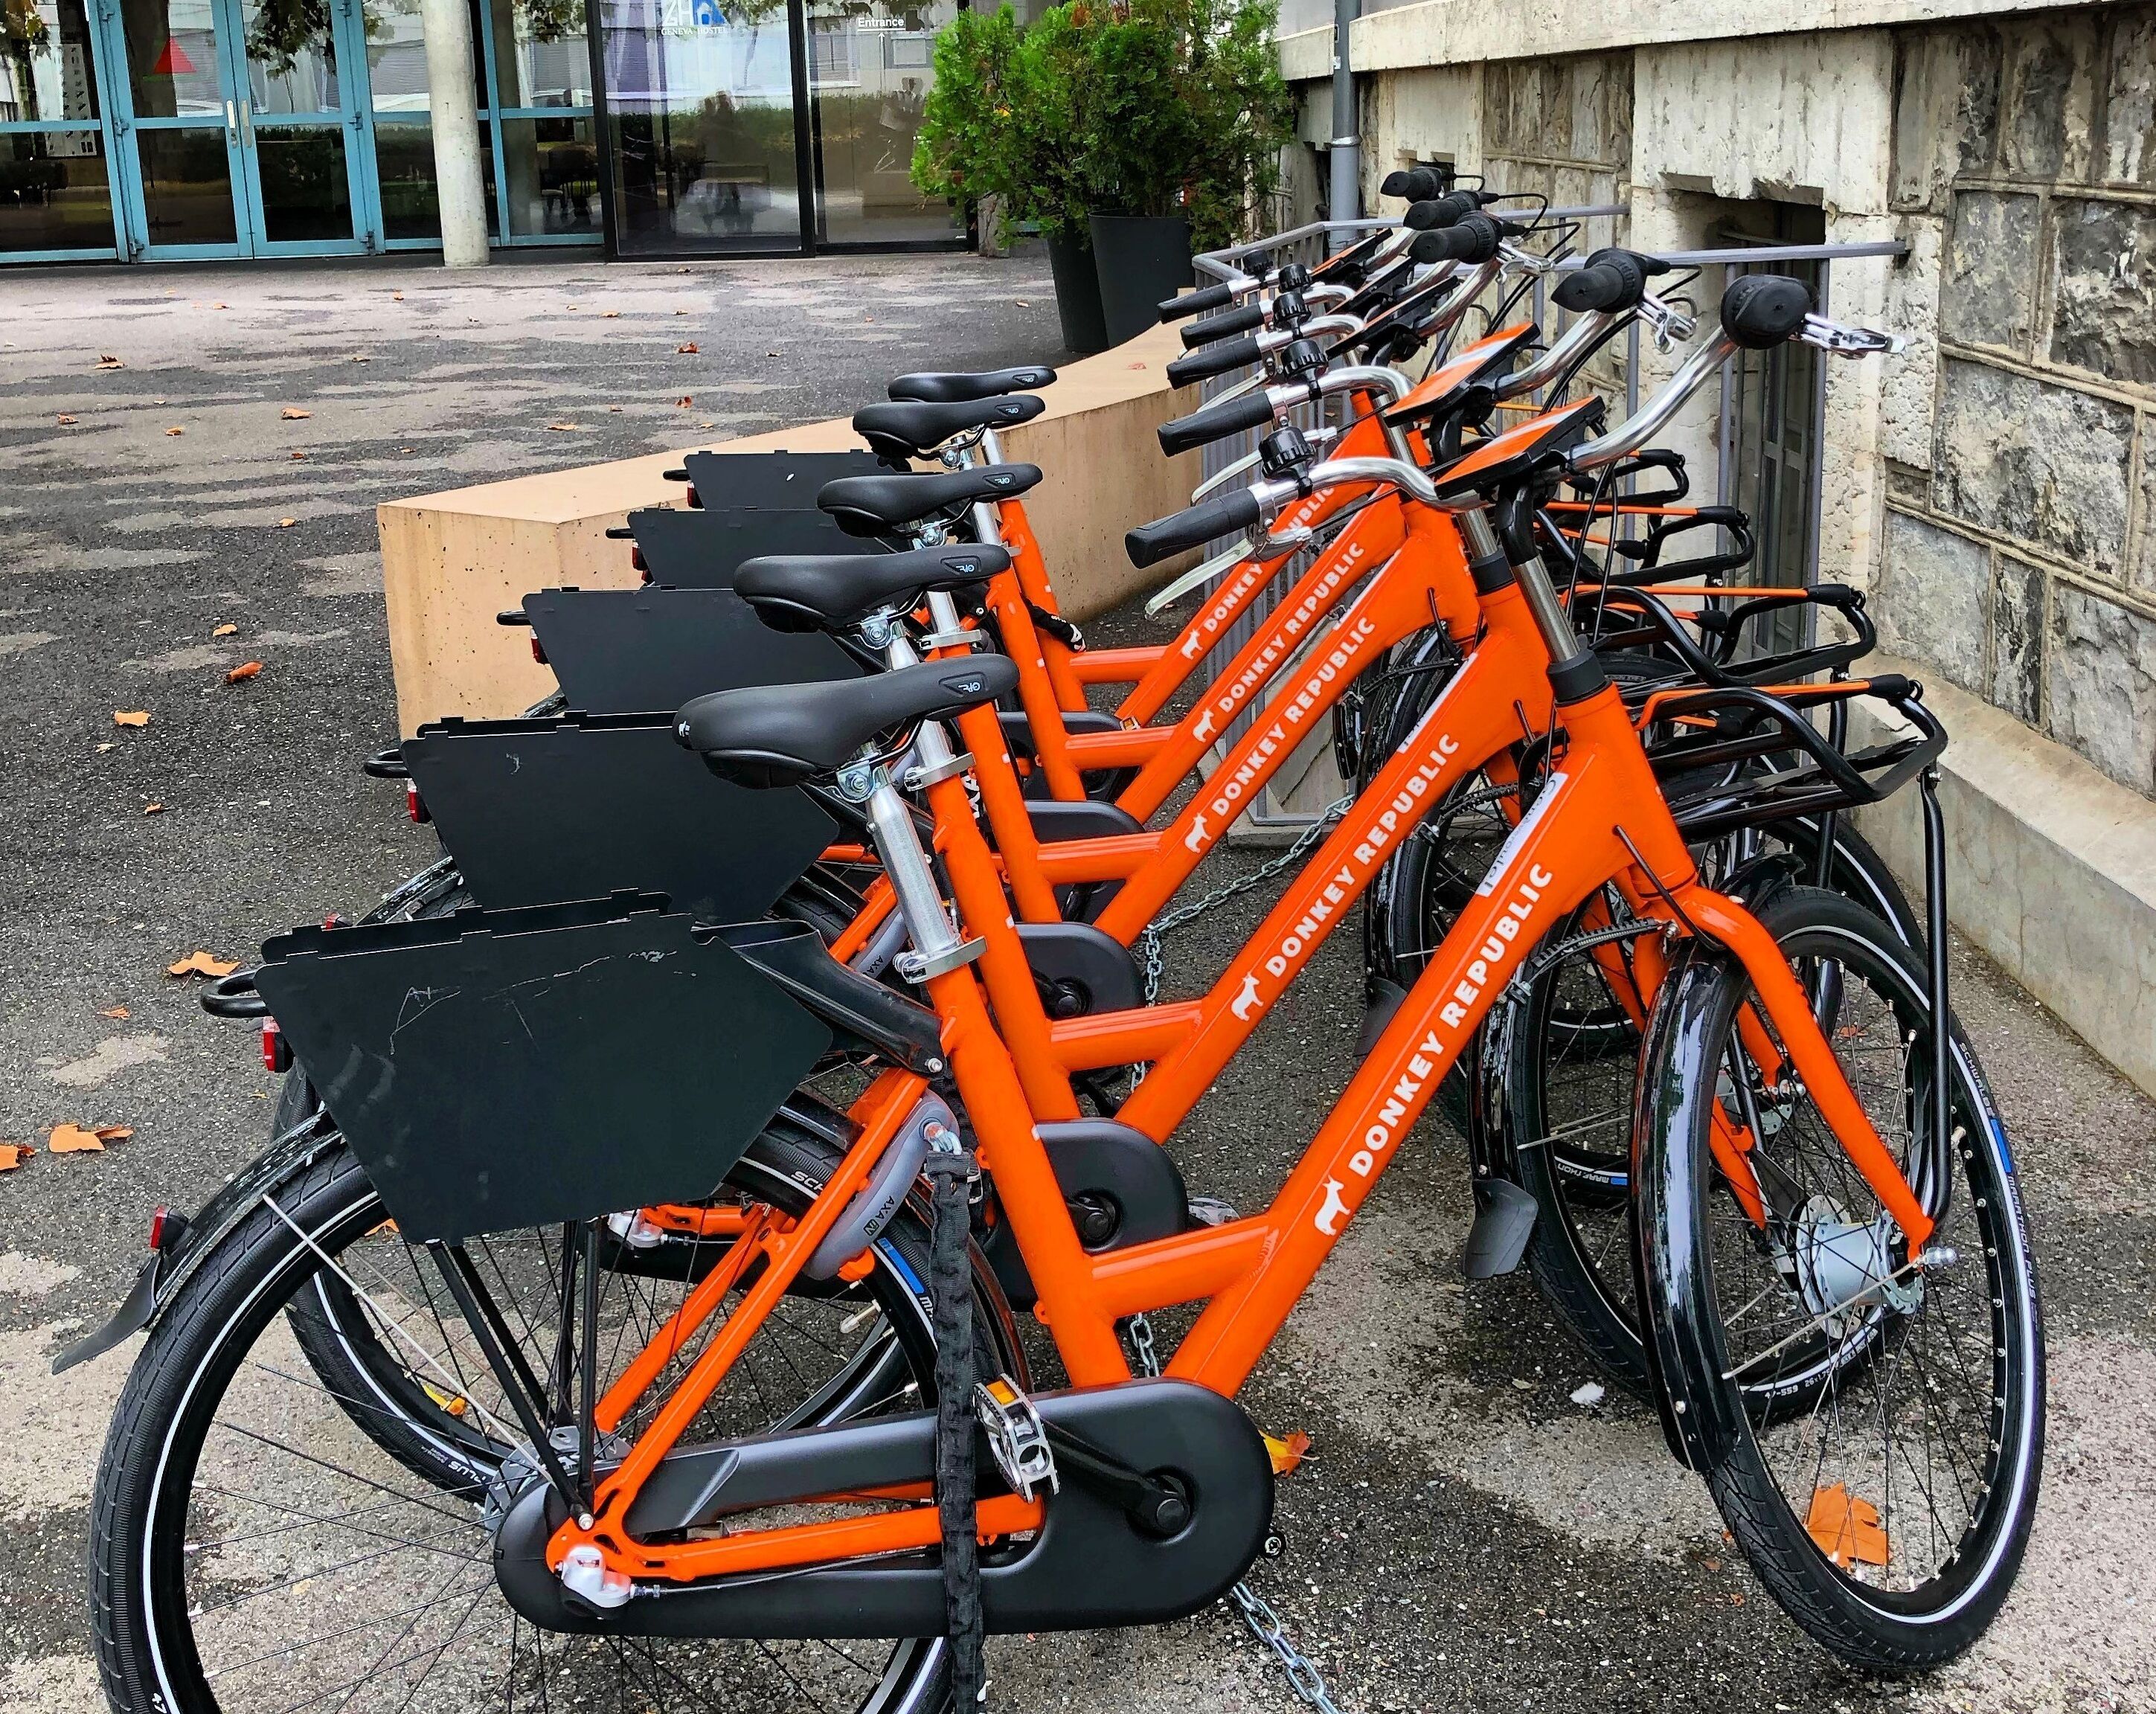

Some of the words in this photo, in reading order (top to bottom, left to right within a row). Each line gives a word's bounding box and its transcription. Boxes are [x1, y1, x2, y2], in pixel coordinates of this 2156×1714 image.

[661, 28, 693, 36] GENEVA
[858, 17, 905, 28] Entrance
[1204, 563, 1263, 633] DONKEY
[1219, 634, 1286, 713] DONKEY
[1285, 542, 1364, 635] REPUBLIC
[1212, 723, 1287, 816] DONKEY
[1284, 617, 1375, 723] REPUBLIC
[1265, 865, 1355, 978] DONKEY
[1354, 734, 1460, 864] REPUBLIC
[867, 954, 884, 974] AXA
[1348, 1030, 1444, 1178] DONKEY
[1440, 863, 1553, 1028] REPUBLIC
[875, 1195, 895, 1219] AXA
[2007, 1175, 2030, 1254] MARATHON
[2024, 1259, 2036, 1299] PLUS
